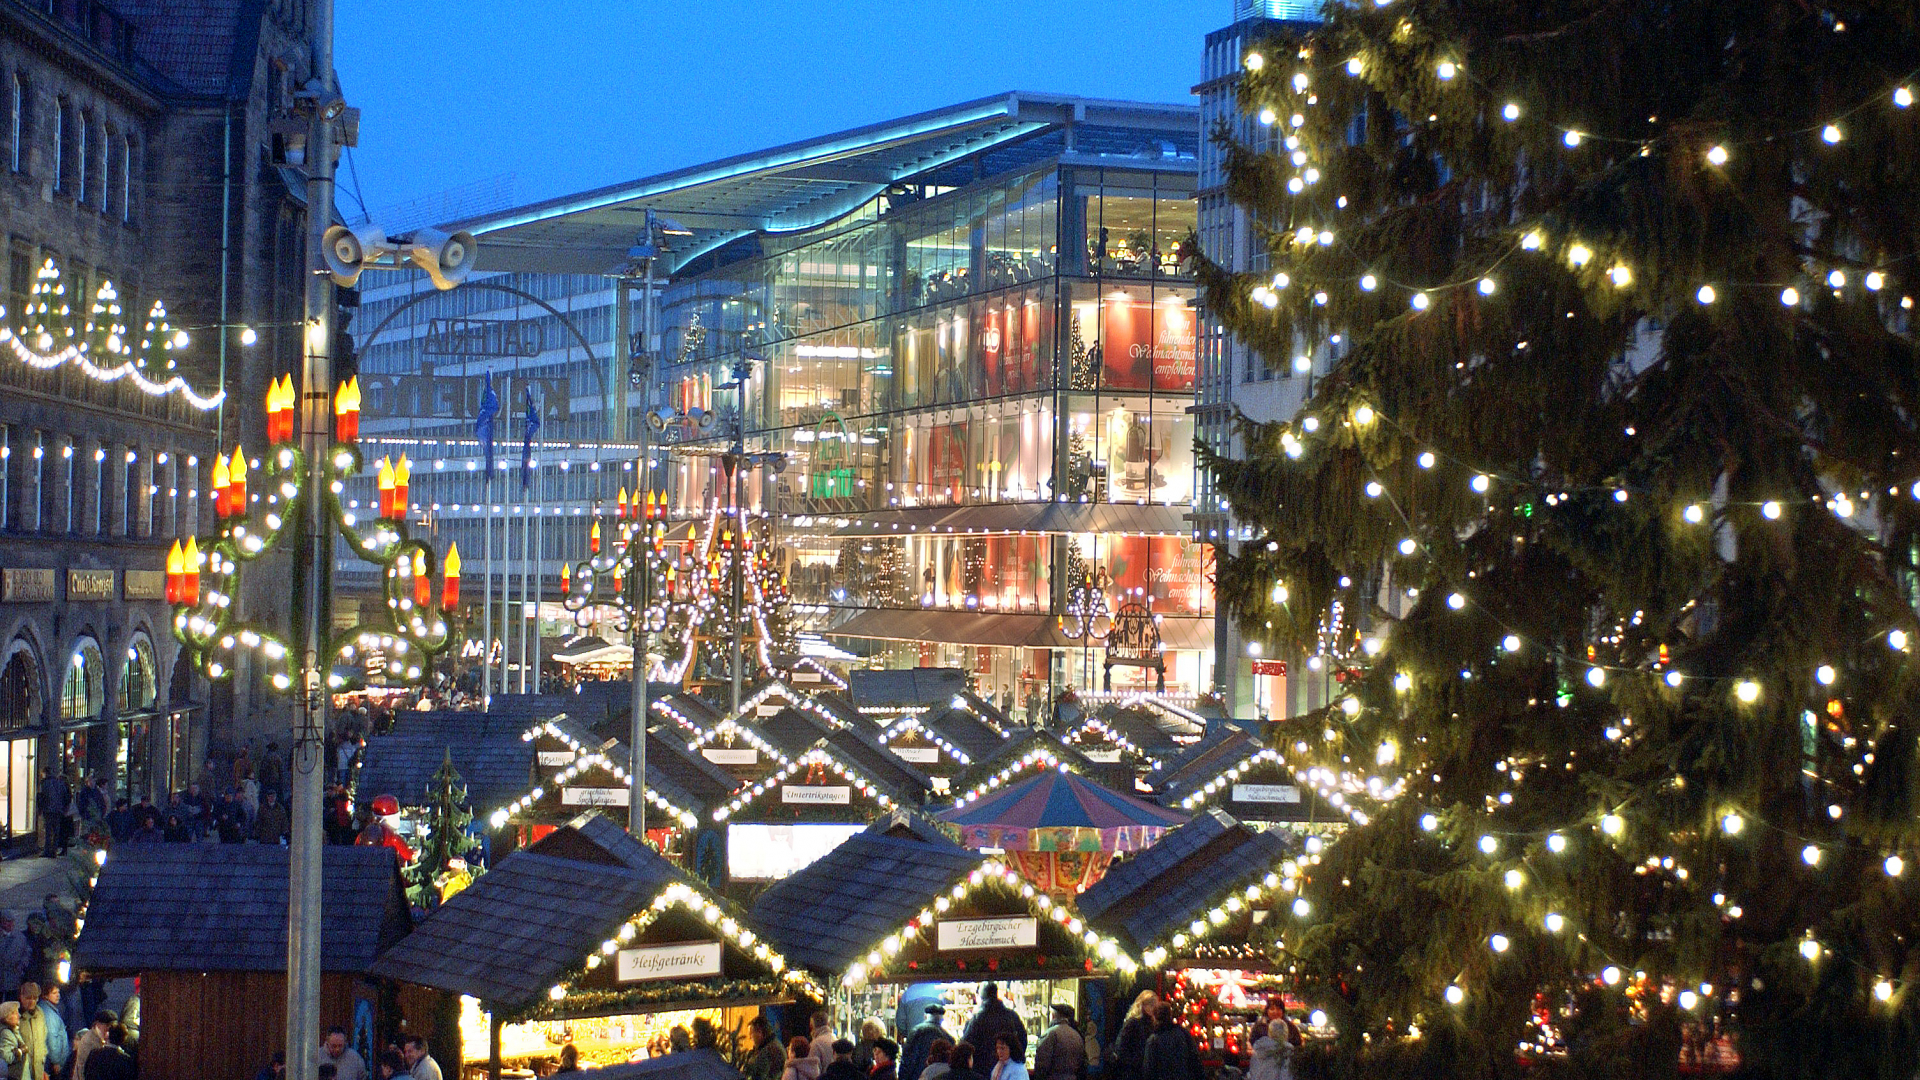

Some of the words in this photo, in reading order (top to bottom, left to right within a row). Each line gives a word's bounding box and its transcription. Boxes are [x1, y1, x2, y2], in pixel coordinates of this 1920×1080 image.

[957, 919, 1022, 936] Erzgebirgischer
[960, 933, 1017, 947] Holzschmuck
[632, 951, 706, 972] Heißgetränke
